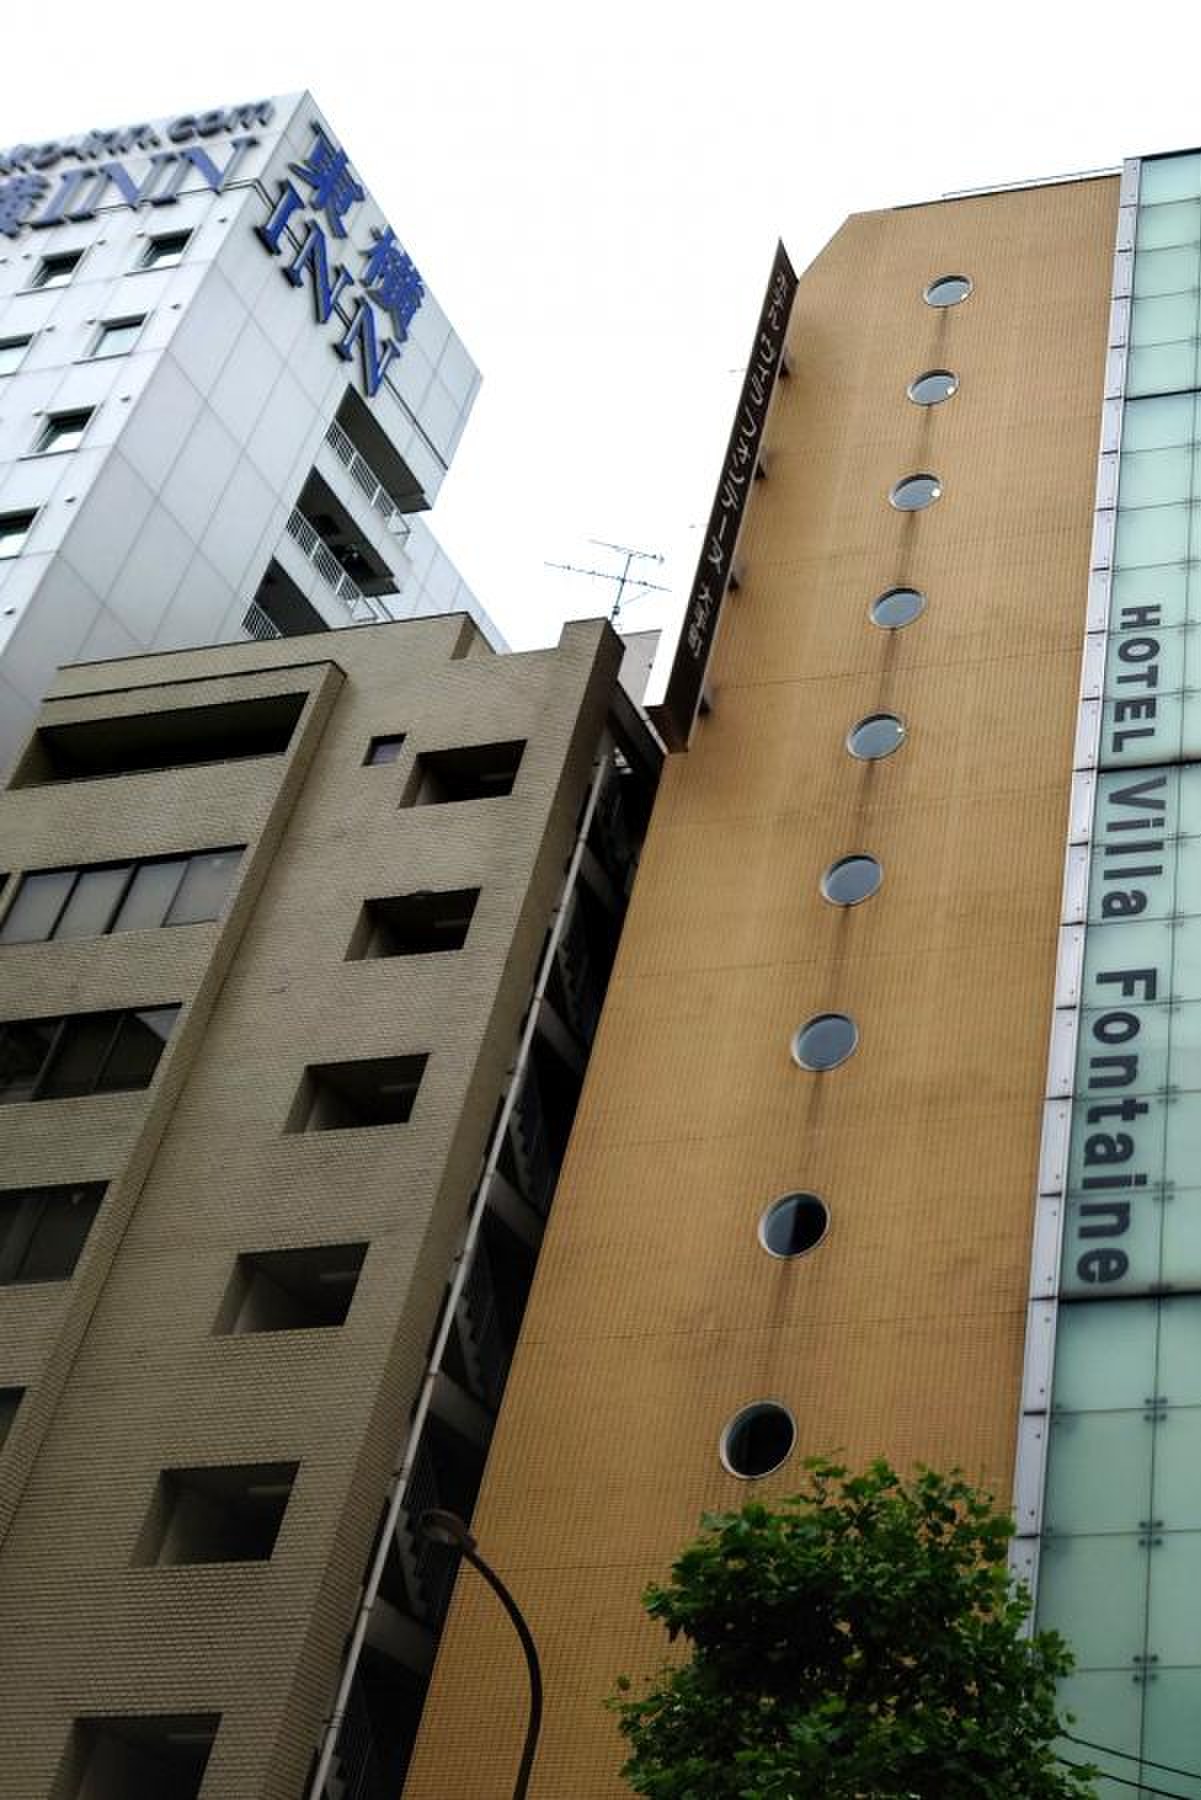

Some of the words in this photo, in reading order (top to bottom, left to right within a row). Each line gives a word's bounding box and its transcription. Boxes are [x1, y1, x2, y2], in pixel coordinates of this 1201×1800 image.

[253, 178, 402, 399] INN
[1112, 604, 1161, 753] HOTEL
[1102, 776, 1167, 919] Villa
[1076, 967, 1158, 1285] Fontaine
